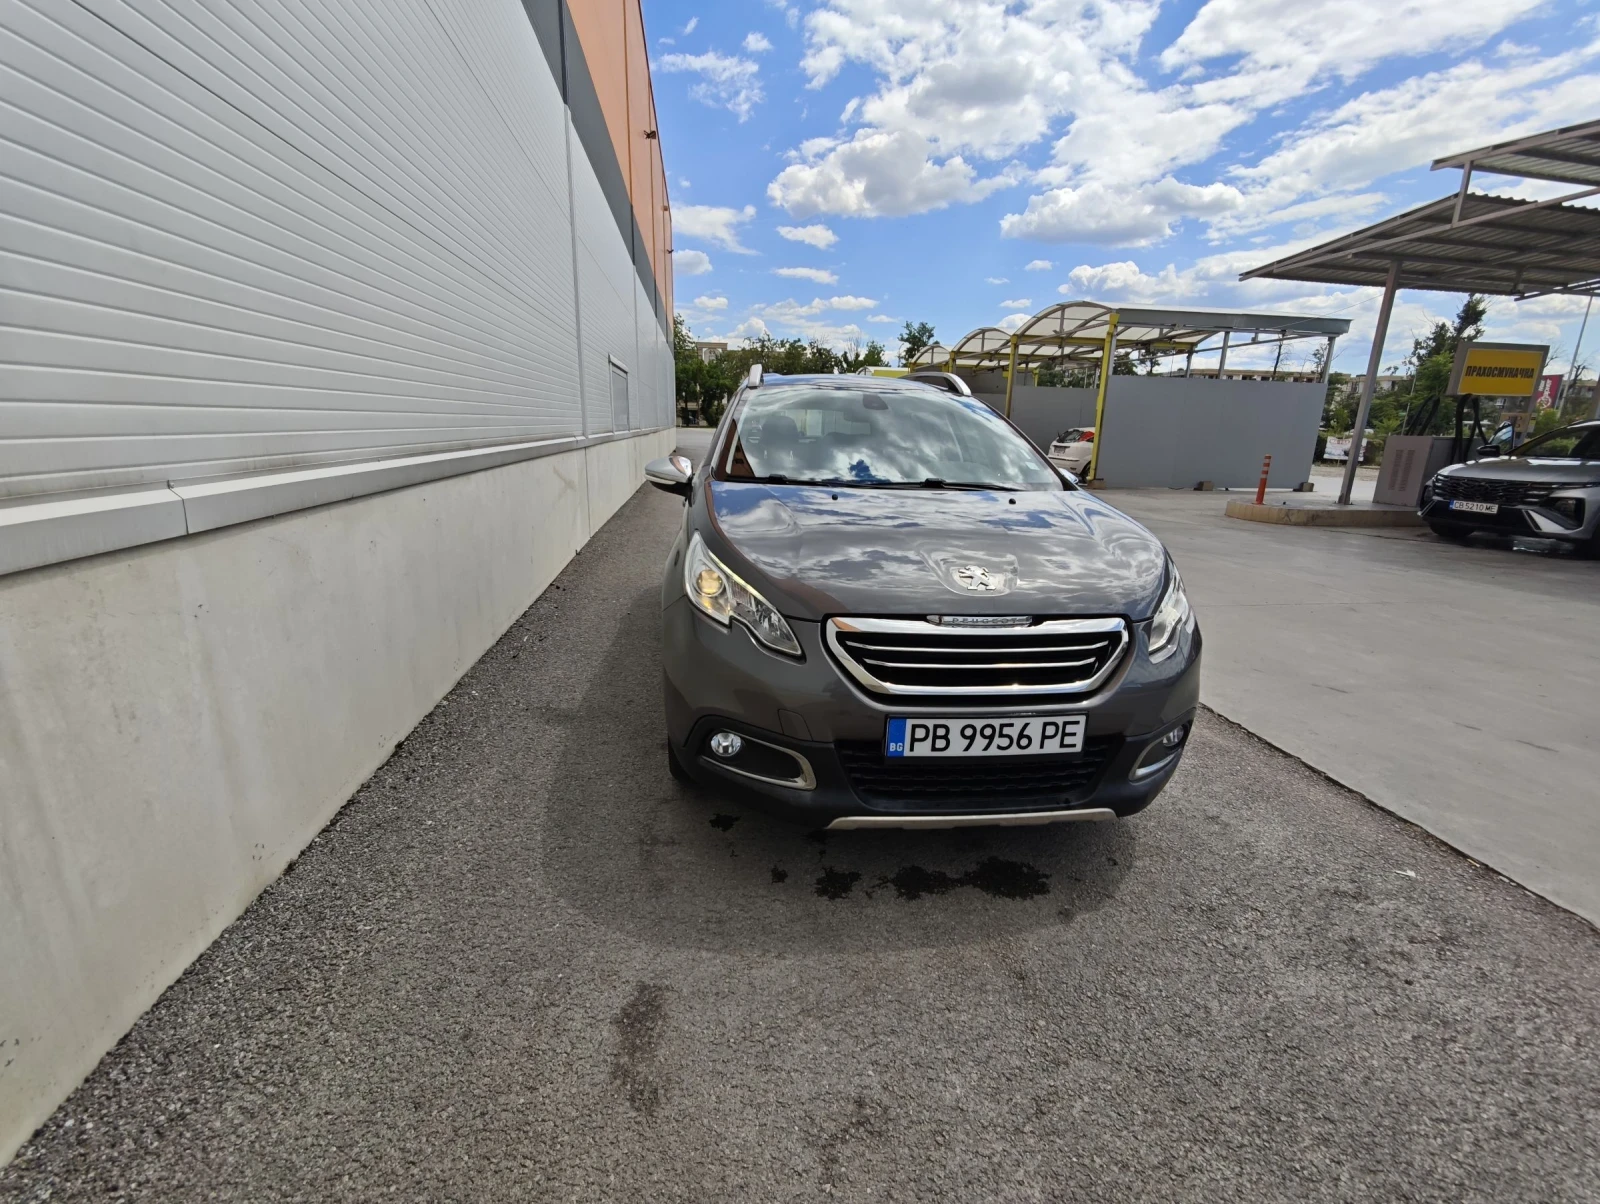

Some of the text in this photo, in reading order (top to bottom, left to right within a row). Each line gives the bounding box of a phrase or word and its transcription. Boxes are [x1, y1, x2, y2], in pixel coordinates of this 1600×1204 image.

[1465, 365, 1535, 379] ПРАХОСМУКАЧКА
[1454, 501, 1496, 513] CB 5210 ME
[909, 720, 1081, 752] PB 9956 PE
[889, 742, 904, 752] BG
